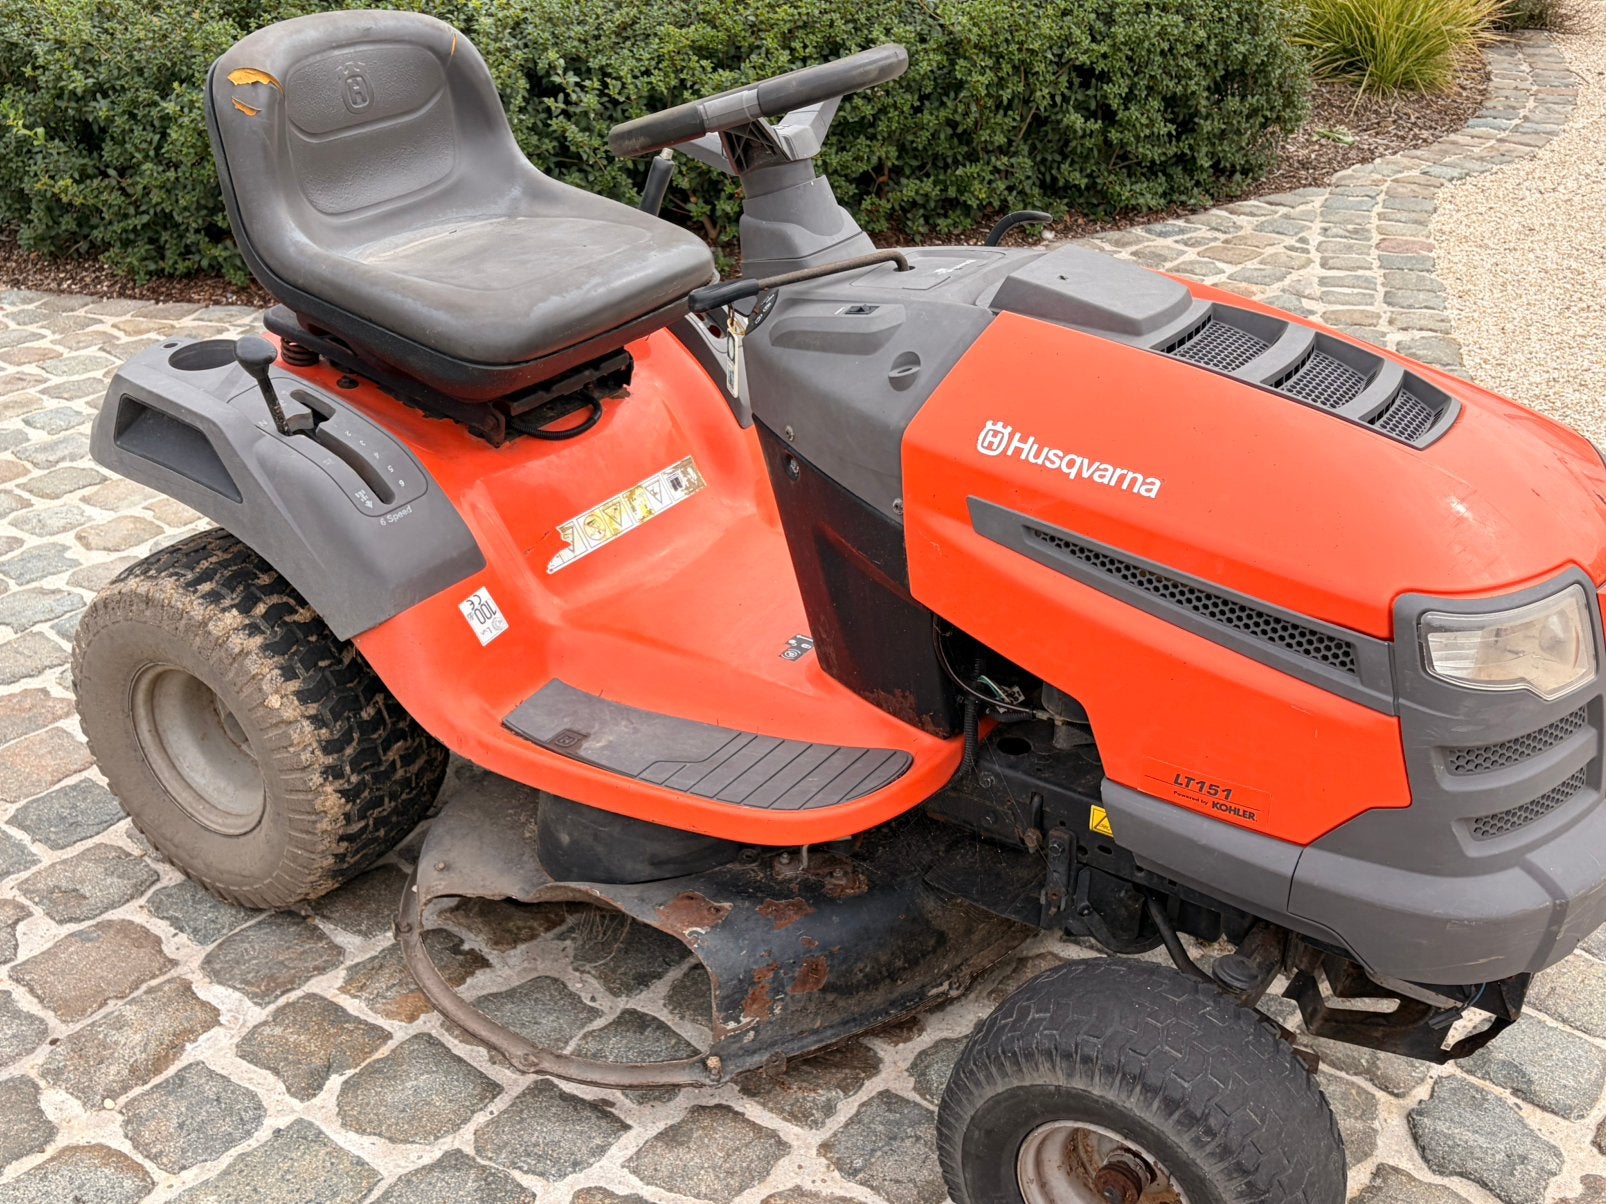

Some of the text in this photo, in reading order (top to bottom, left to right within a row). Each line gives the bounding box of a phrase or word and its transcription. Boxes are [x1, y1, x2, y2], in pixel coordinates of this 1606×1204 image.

[1006, 432, 1162, 499] Husqvarna
[380, 504, 412, 526] 6 Speed
[474, 600, 498, 625] 100
[1173, 773, 1233, 801] LT151
[1173, 790, 1256, 821] Powered by KOHLER
